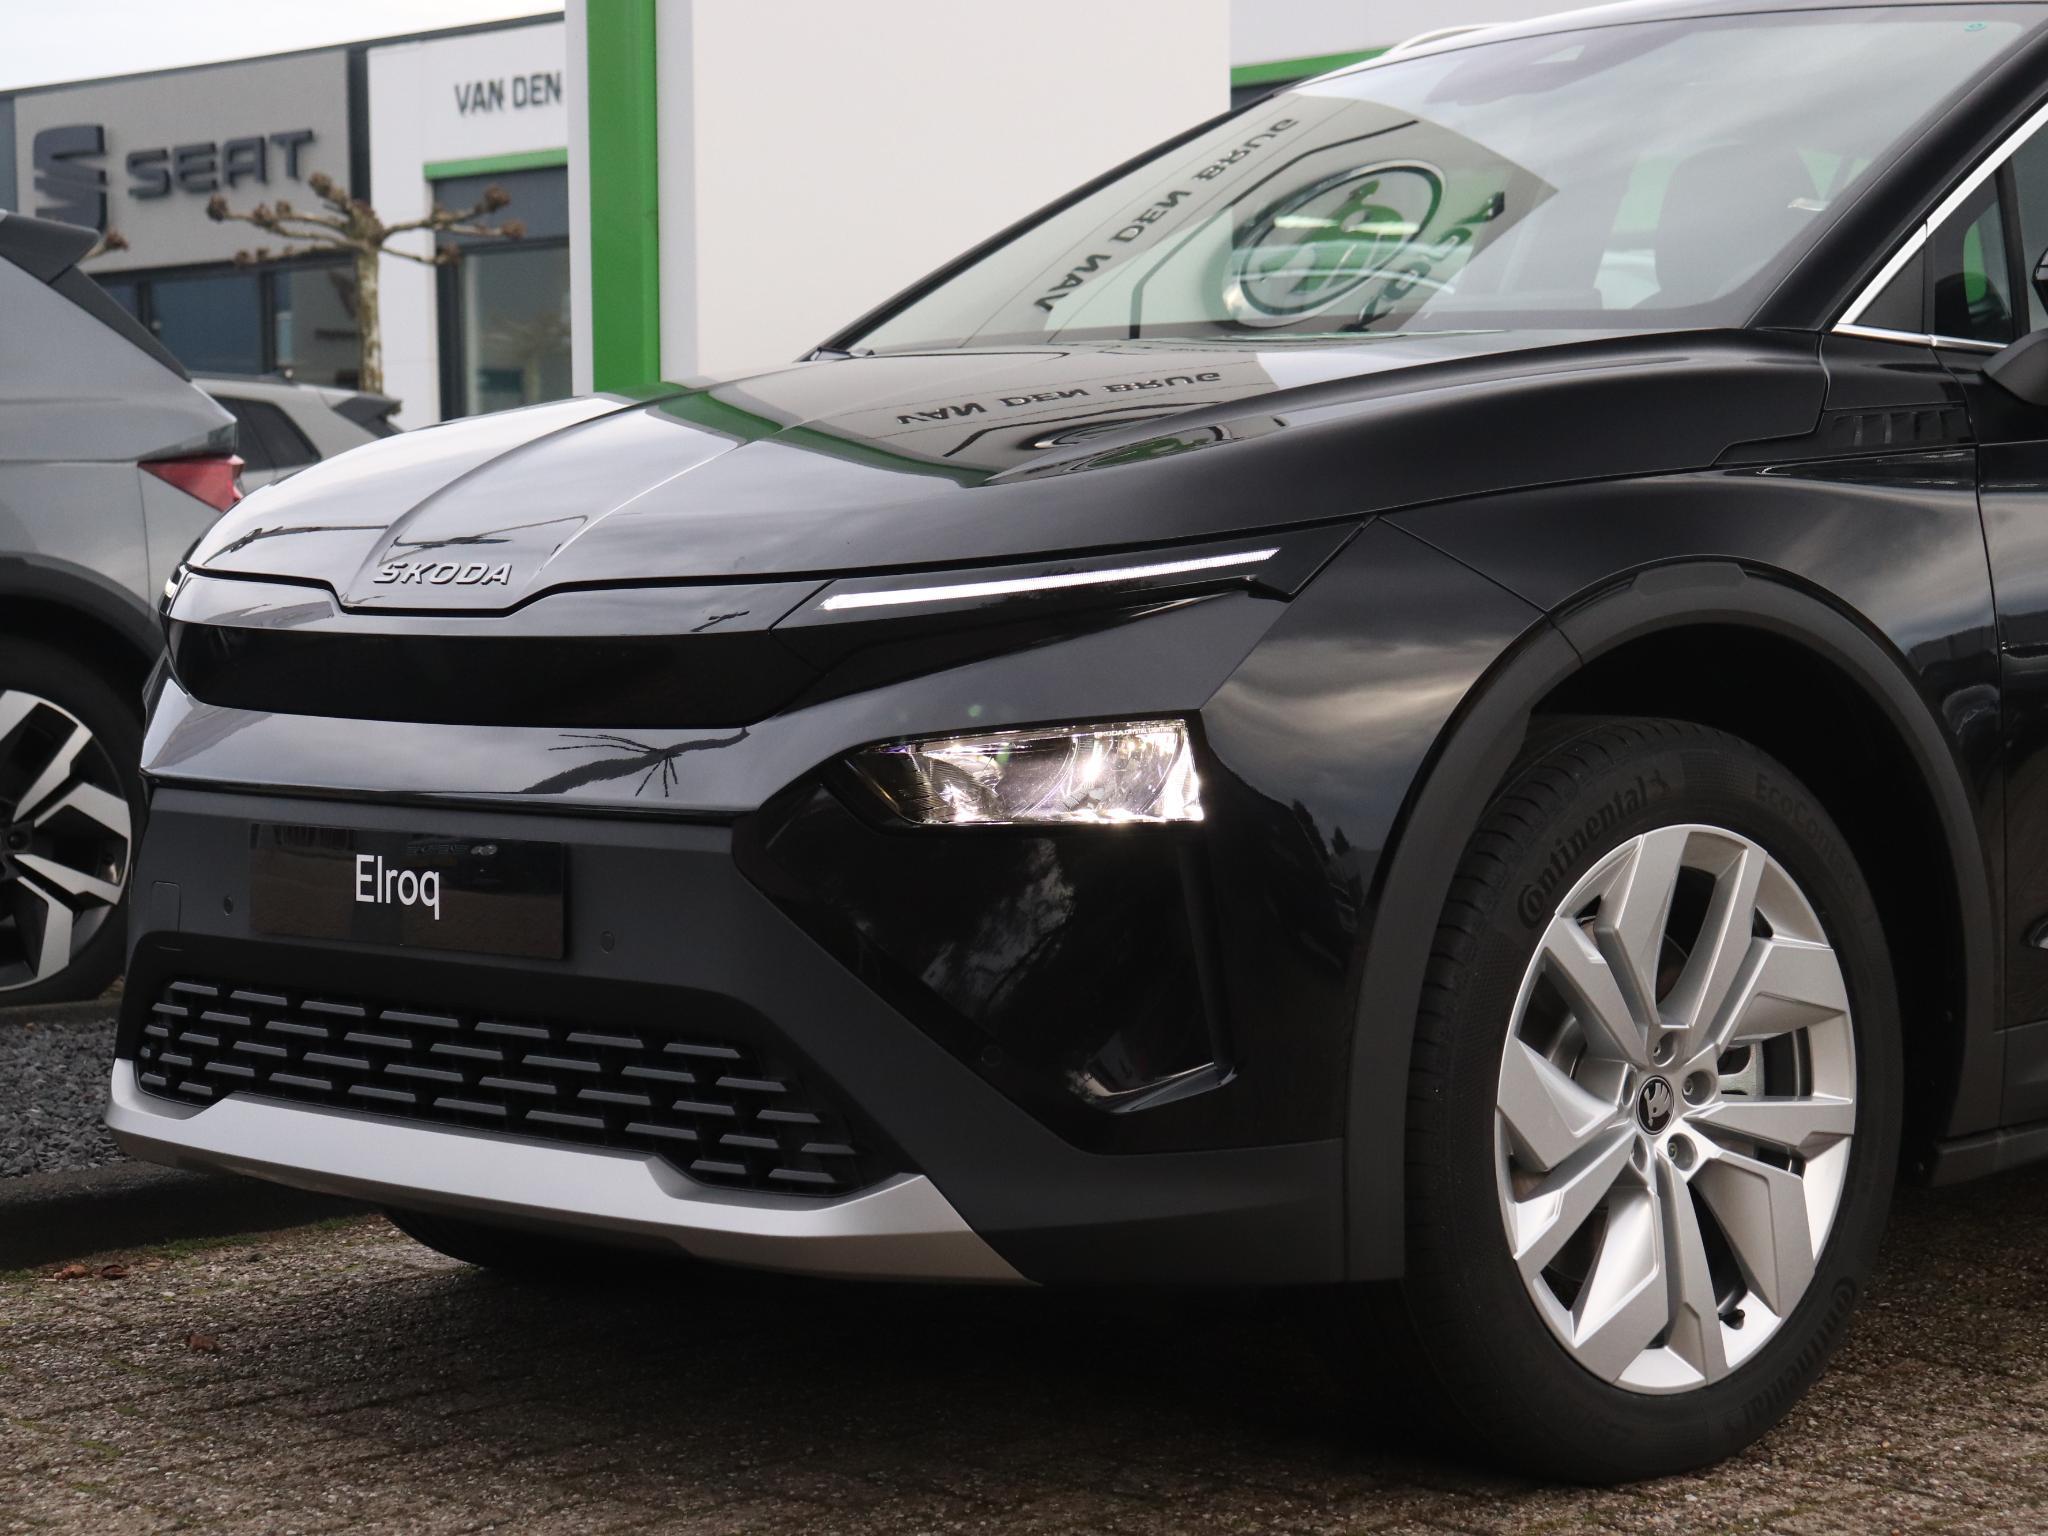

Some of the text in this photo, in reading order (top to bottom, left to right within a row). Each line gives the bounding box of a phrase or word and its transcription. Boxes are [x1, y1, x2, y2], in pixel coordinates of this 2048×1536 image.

[455, 72, 562, 116] VAN DEN
[126, 129, 314, 200] SEAT
[355, 853, 440, 920] Elroq
[1517, 775, 1648, 930] Continental
